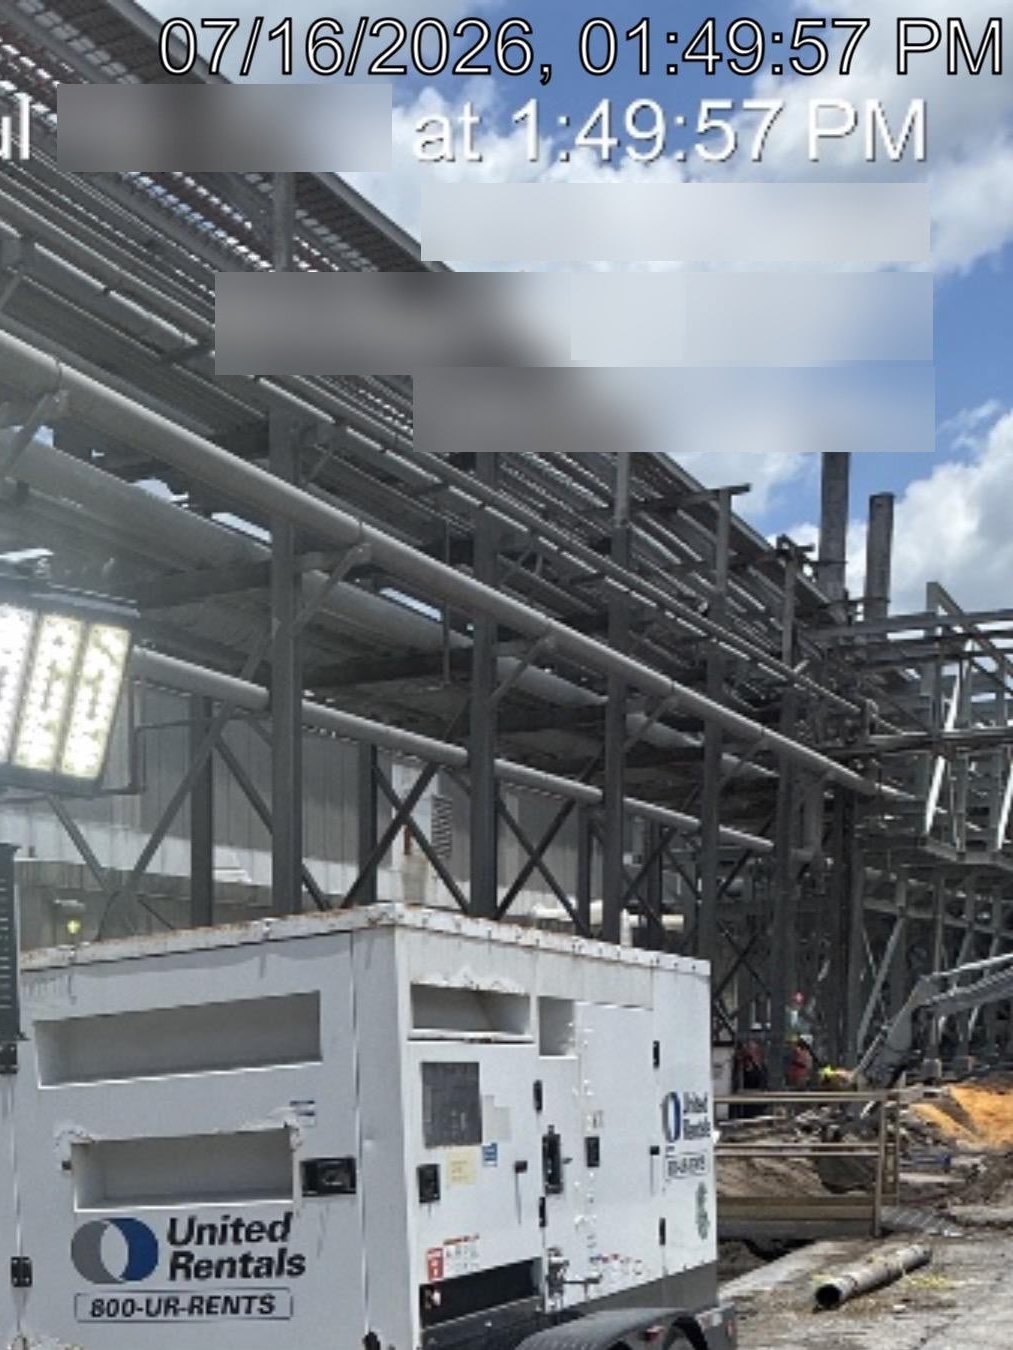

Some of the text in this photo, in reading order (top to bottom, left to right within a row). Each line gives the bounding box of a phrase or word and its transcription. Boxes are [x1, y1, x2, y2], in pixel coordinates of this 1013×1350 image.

[166, 1211, 294, 1247] United
[167, 1247, 307, 1282] Rentals
[89, 1293, 277, 1319] 800-UR-RENTS
